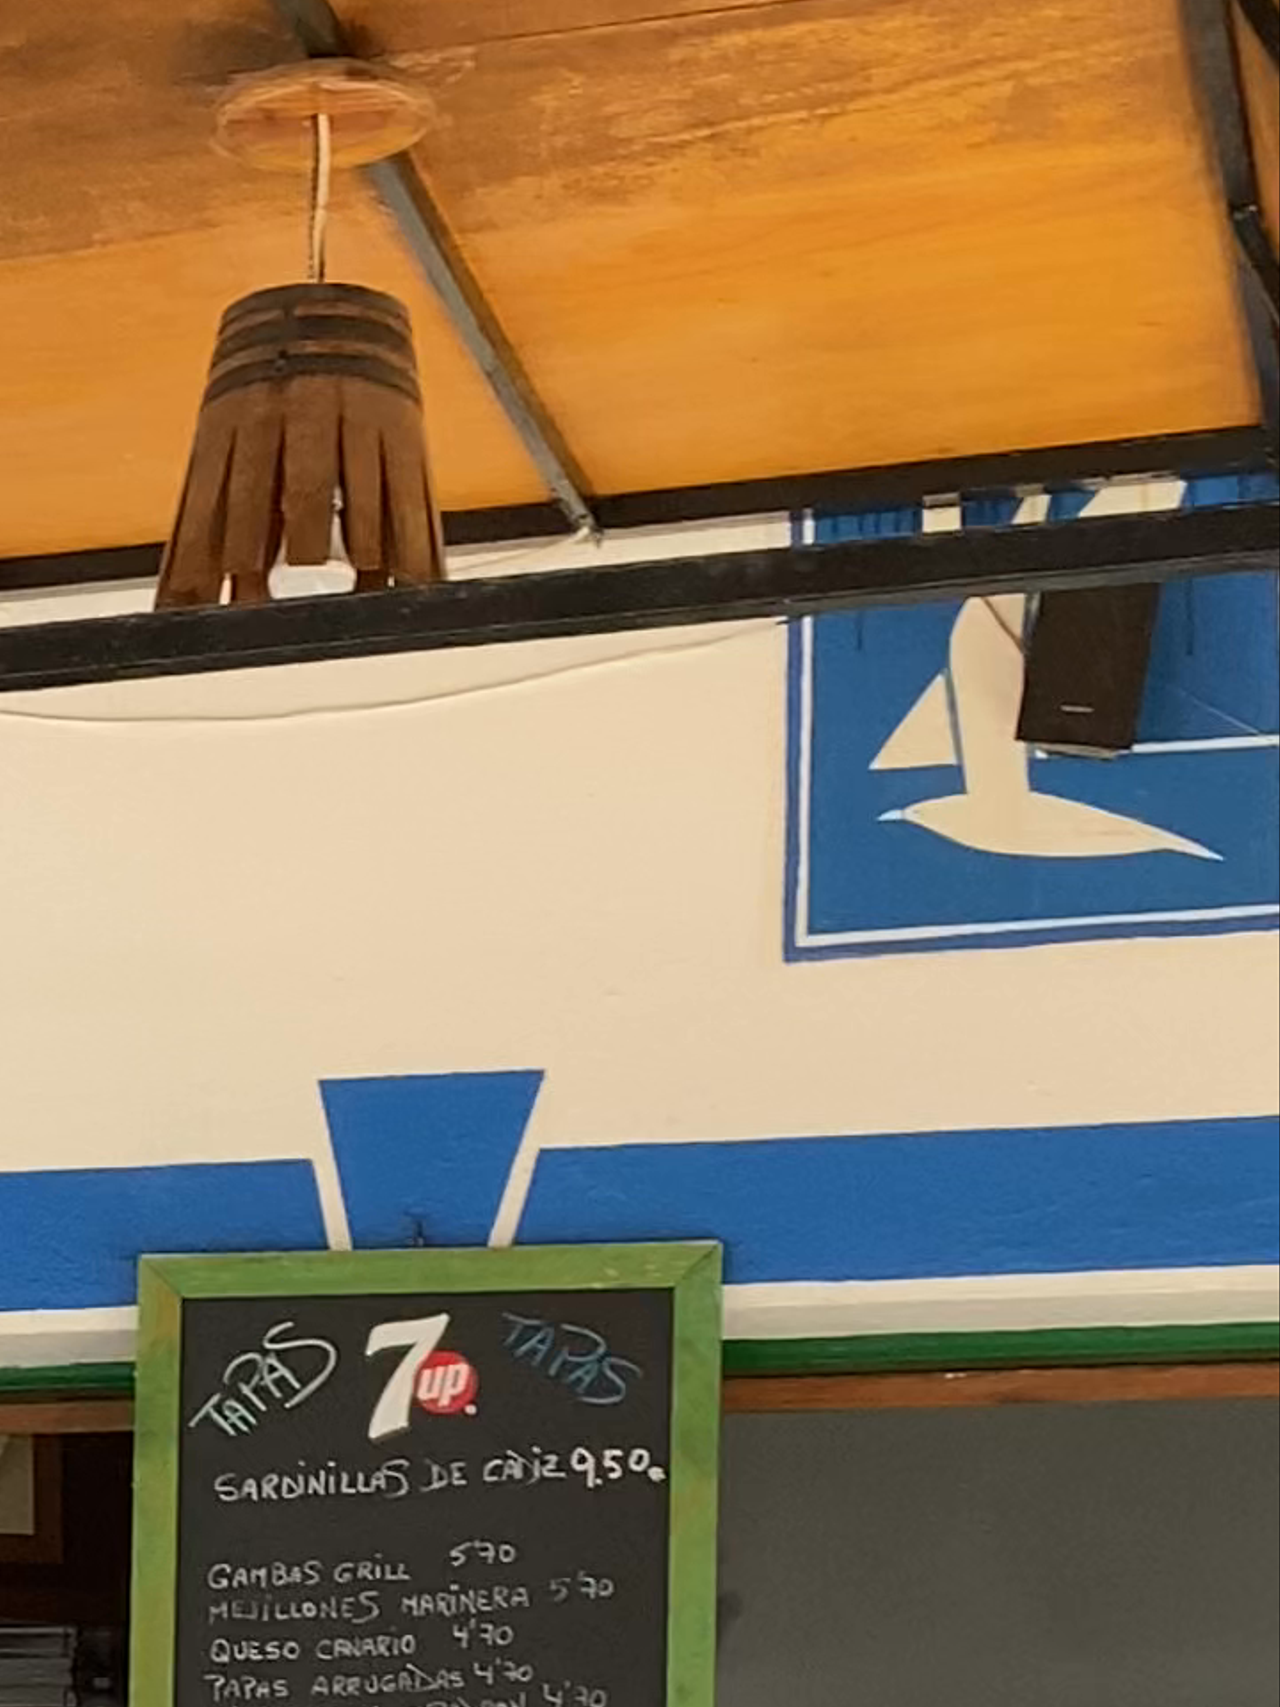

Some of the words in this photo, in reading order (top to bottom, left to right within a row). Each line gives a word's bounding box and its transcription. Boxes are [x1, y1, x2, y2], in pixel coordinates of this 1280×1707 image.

[500, 1311, 643, 1405] TAPAS
[189, 1321, 337, 1436] TAPAS
[419, 1457, 468, 1492] DE
[207, 1560, 323, 1590] GAMBAS
[333, 1553, 412, 1583] GRILL
[208, 1591, 380, 1625] MEJILLONES
[401, 1584, 530, 1616] MARINERA
[210, 1638, 300, 1663] QUESO
[315, 1633, 417, 1660] CANARIO
[203, 1674, 290, 1701] PAPAS
